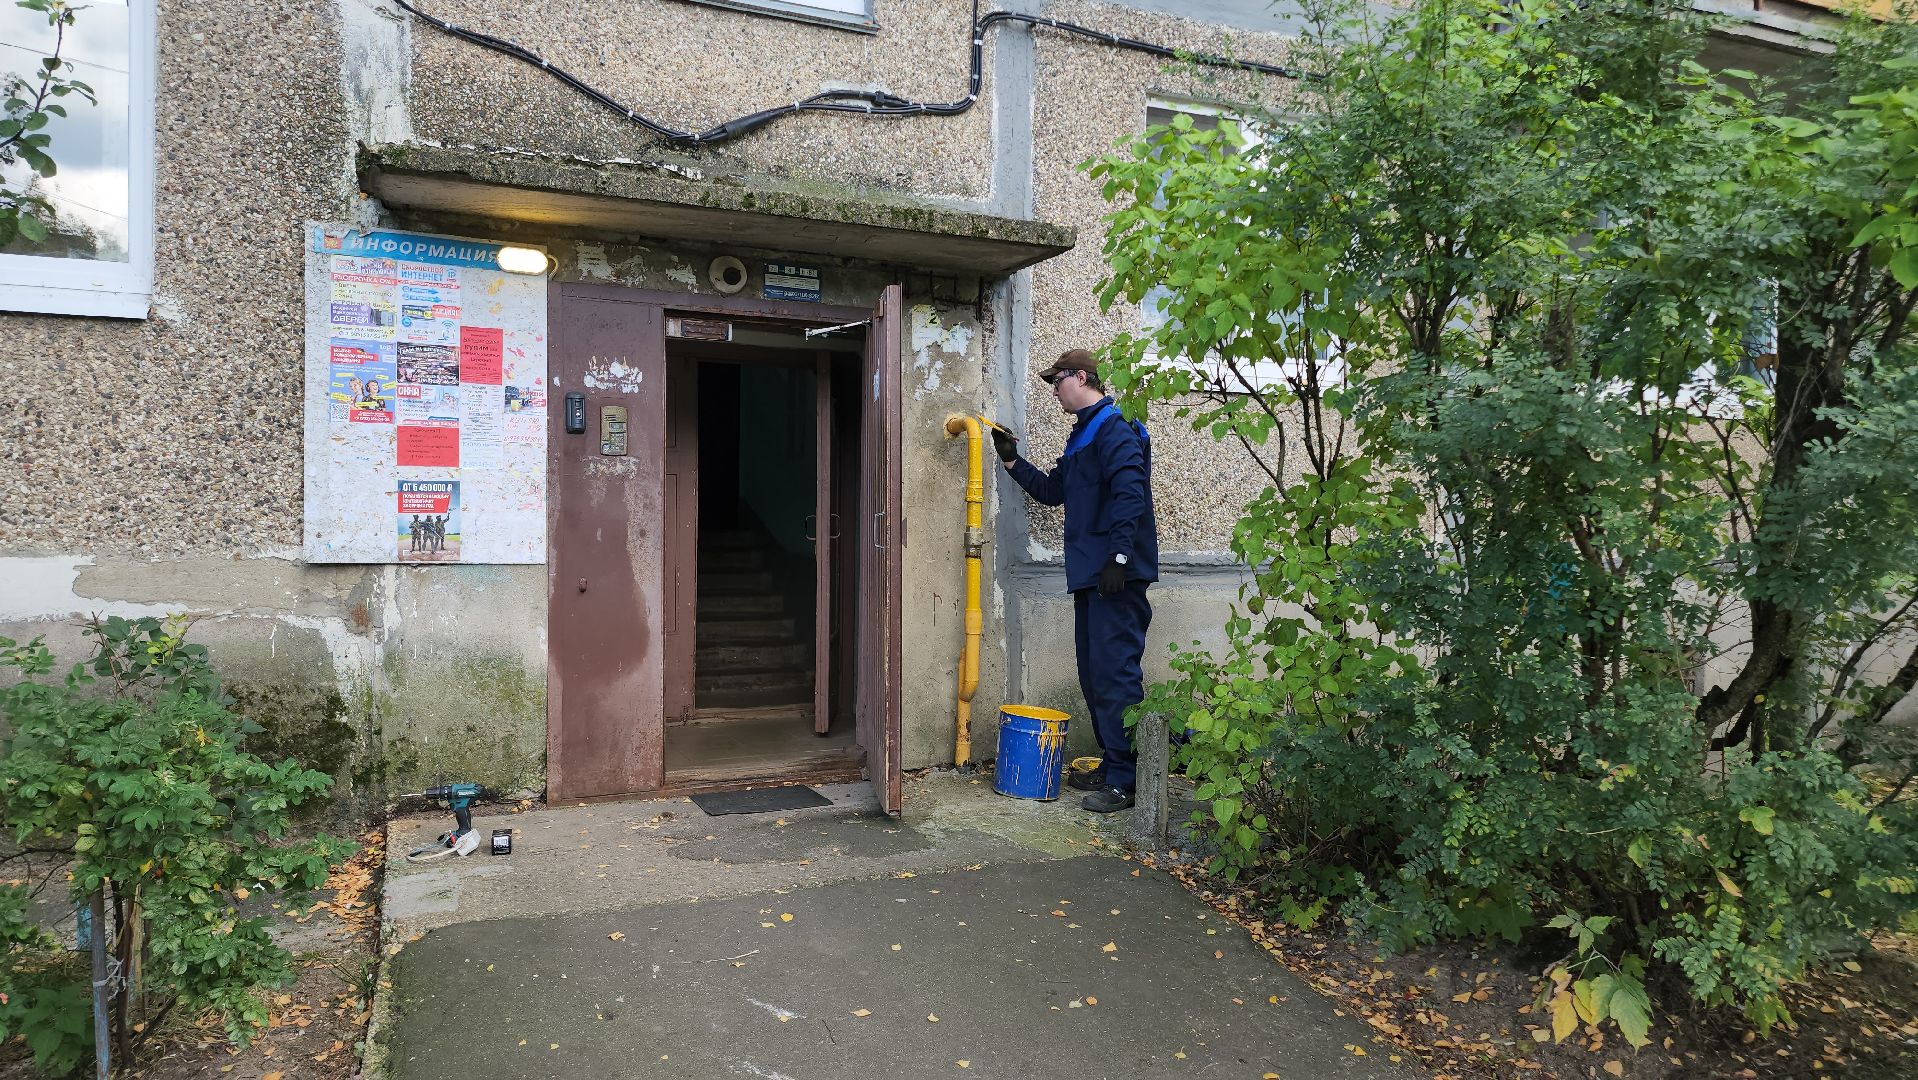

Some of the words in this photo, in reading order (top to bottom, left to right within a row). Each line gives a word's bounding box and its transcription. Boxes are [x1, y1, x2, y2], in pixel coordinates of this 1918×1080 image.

[351, 237, 496, 263] ИНФОРМАЦИЯ
[401, 271, 443, 281] ИНТЕРНЕТ
[333, 315, 369, 324] ДВЕРЕЙ
[398, 386, 420, 396] ОКНА
[403, 483, 411, 492] ОТ
[433, 483, 446, 492] 000
